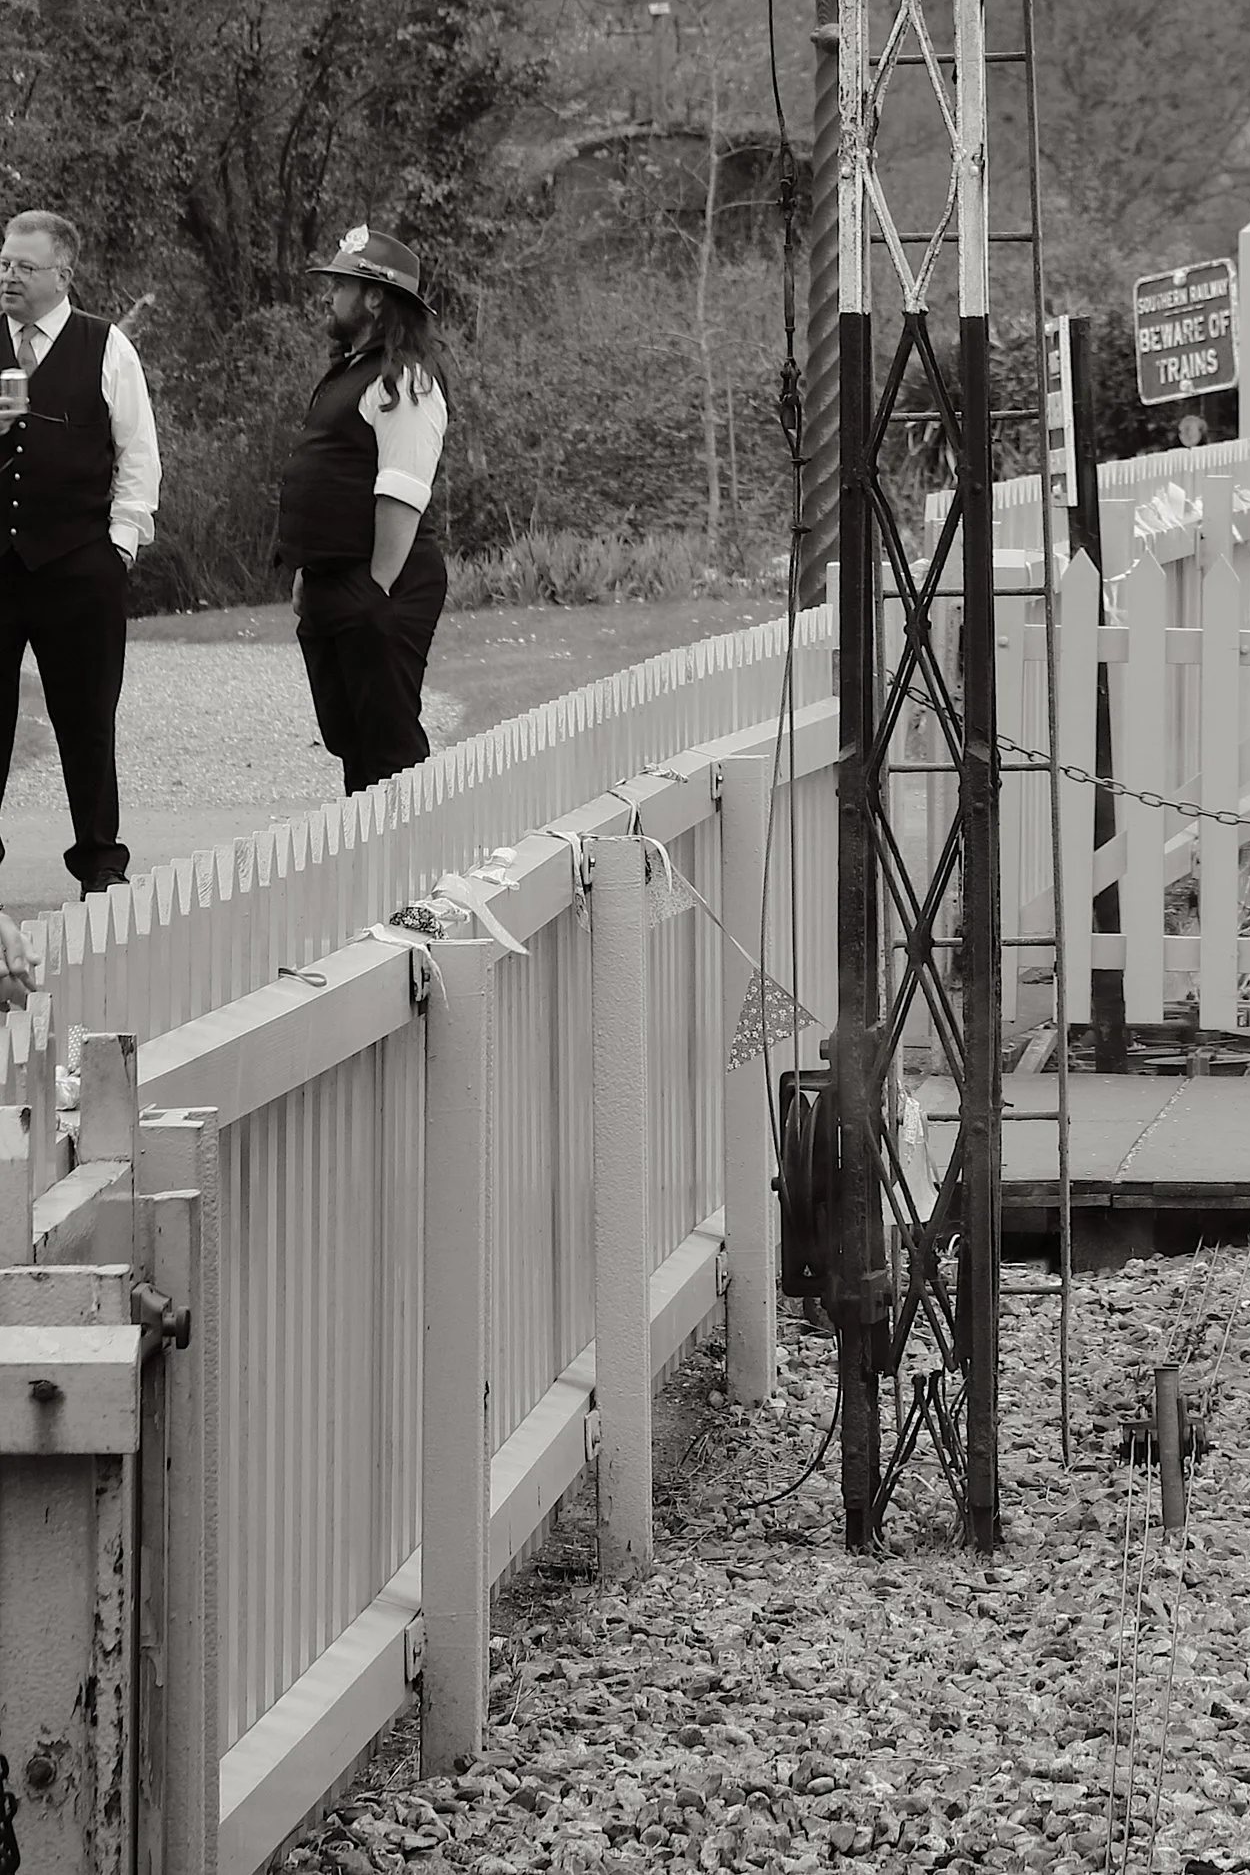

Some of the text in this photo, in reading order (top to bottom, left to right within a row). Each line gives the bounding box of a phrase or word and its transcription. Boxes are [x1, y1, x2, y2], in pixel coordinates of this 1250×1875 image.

[1137, 278, 1229, 315] SOUTHERN RAILWAY
[1139, 309, 1231, 353] BEWARE OF
[1155, 348, 1219, 385] TRAINS
